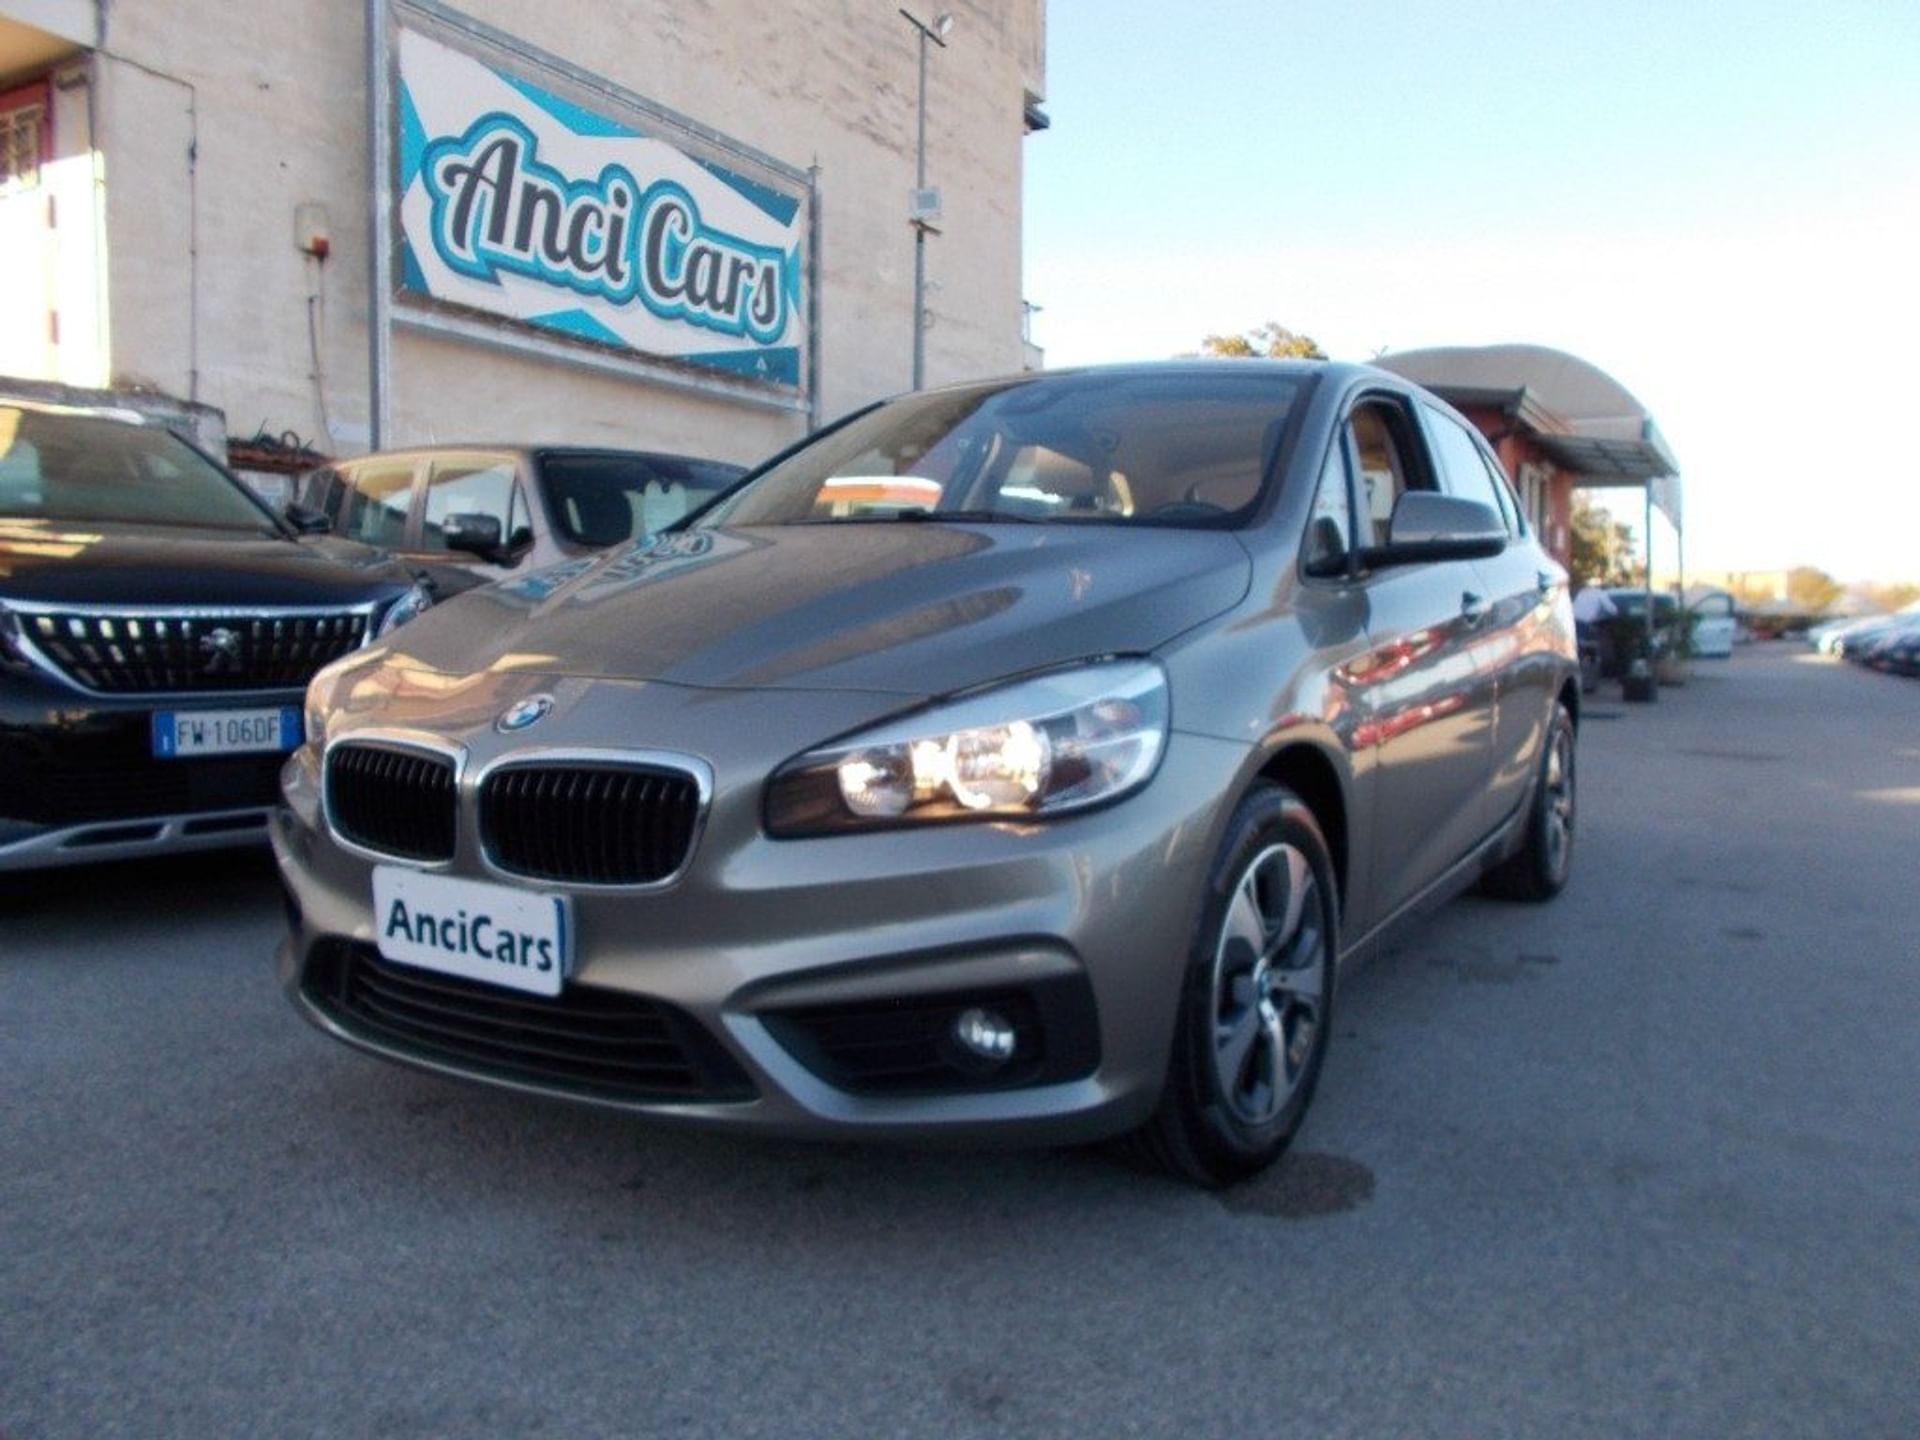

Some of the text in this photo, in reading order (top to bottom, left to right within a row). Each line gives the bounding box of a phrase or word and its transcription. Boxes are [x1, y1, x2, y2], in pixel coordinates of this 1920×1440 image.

[442, 137, 776, 326] Anci Cars
[386, 899, 553, 972] AnciCars
